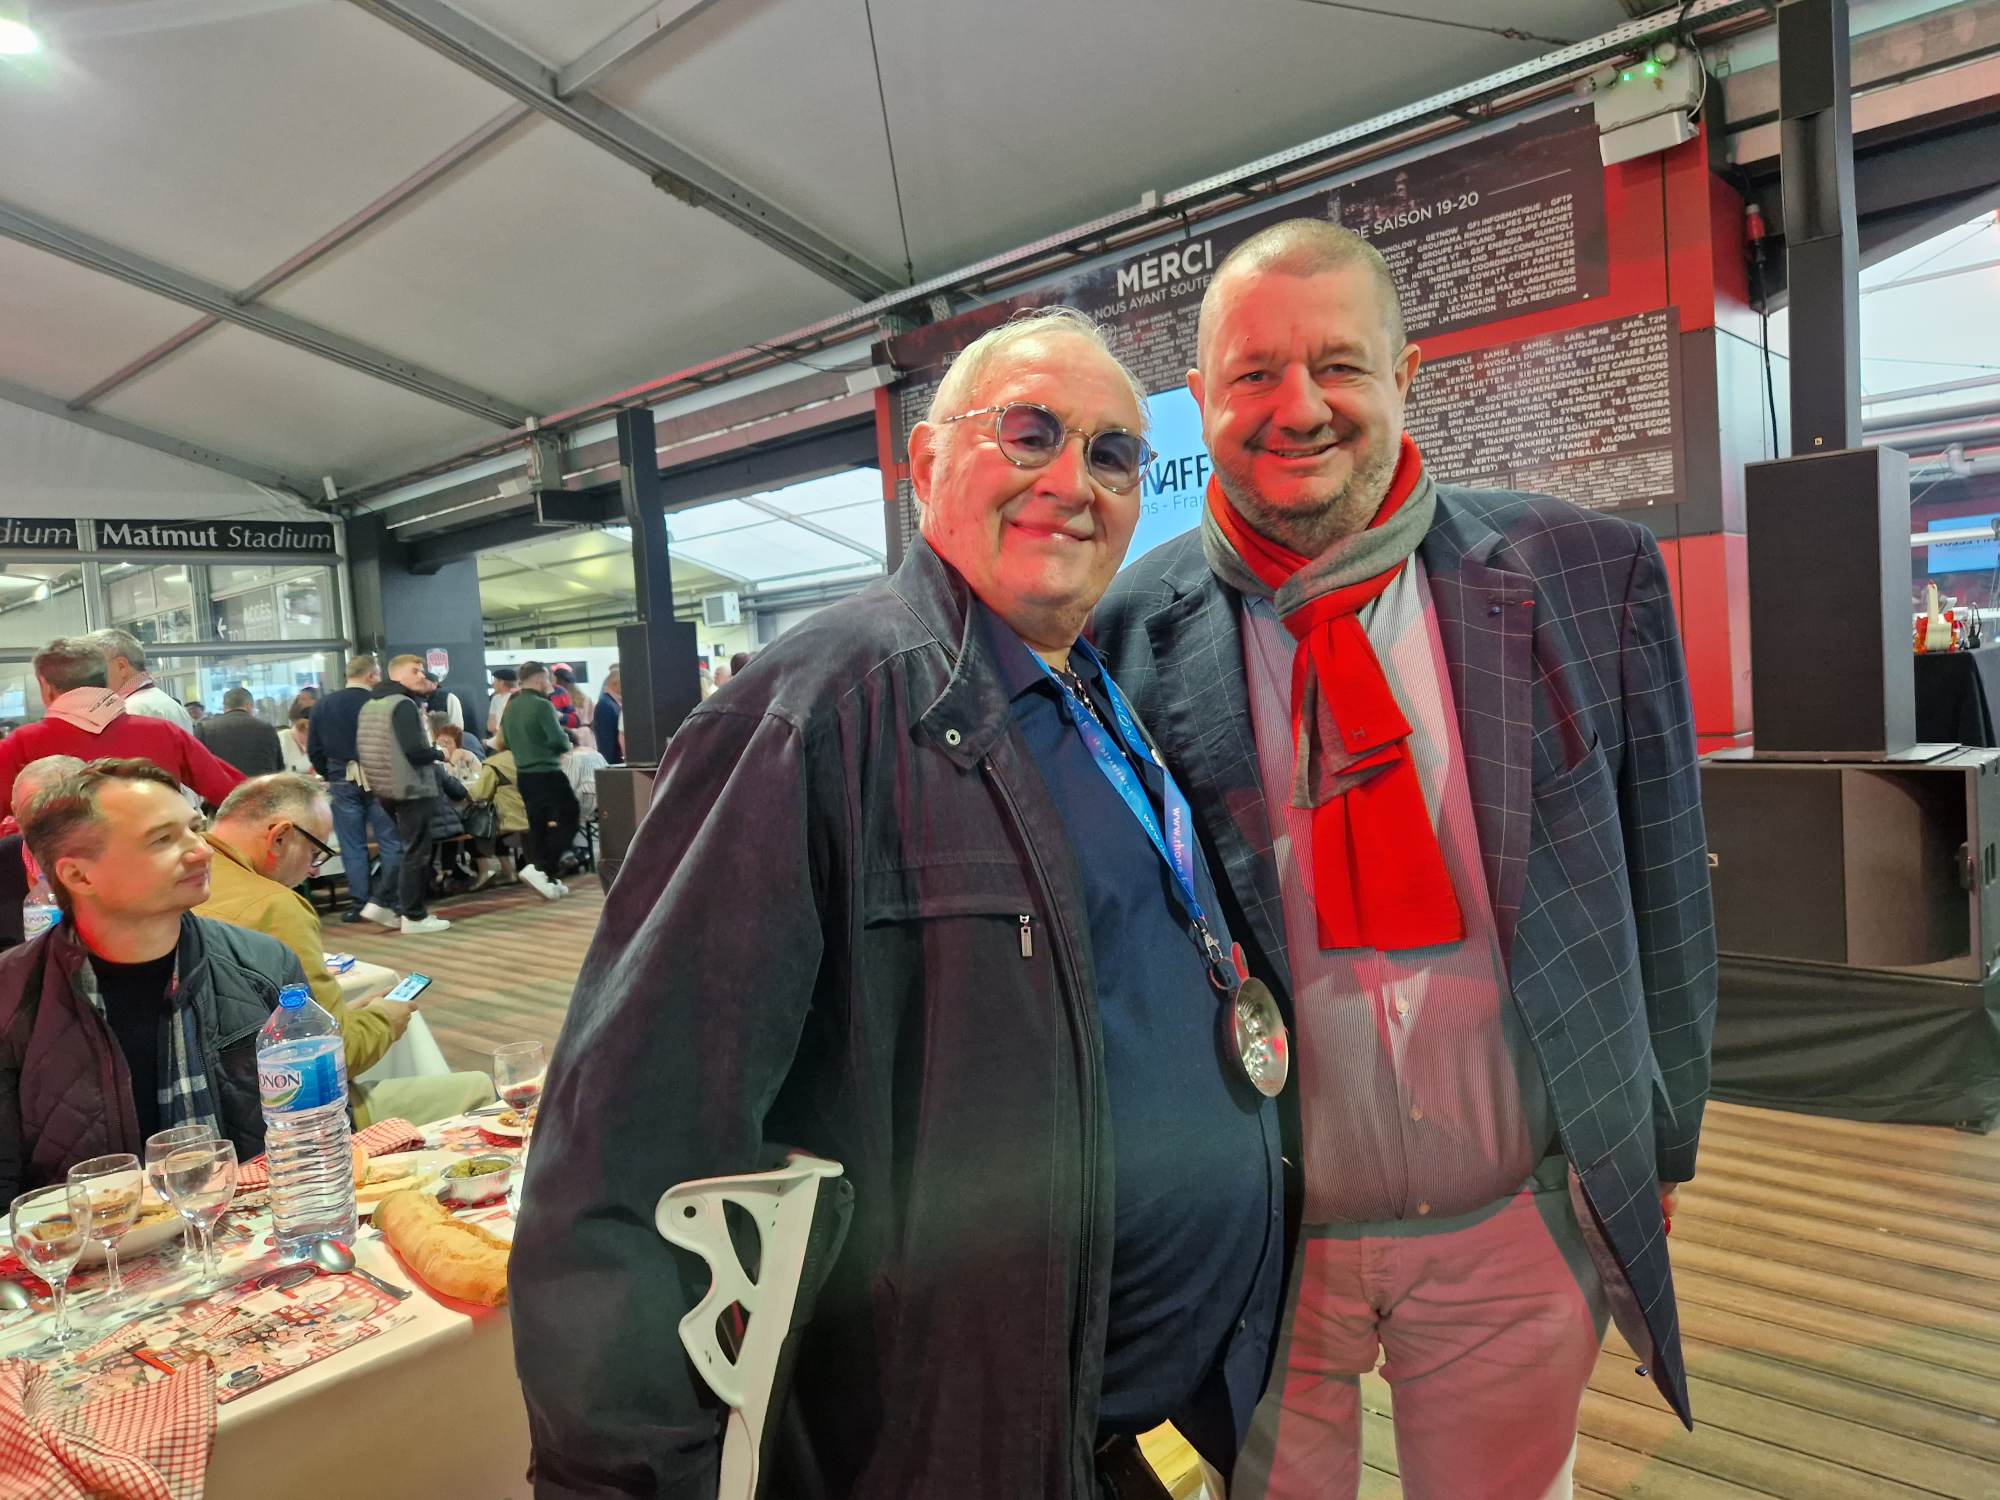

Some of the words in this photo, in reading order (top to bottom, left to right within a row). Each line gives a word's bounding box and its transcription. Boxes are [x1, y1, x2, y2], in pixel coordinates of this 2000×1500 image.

[1382, 238, 1416, 255] HNOLOGY
[1425, 226, 1458, 242] GETNOW
[1467, 220, 1480, 230] GFI
[1481, 202, 1540, 226] INFORMATIQUE
[1416, 234, 1461, 253] GROUPAMA
[1524, 202, 1572, 223] AUVERGNE
[1417, 255, 1447, 270] GROUPE
[1449, 251, 1459, 261] VT
[1487, 234, 1523, 251] ENERGIA
[1534, 220, 1573, 238] GUINTOLI
[1421, 245, 1451, 260] GROUPE
[1504, 221, 1538, 237] GROUPE
[1539, 211, 1573, 228] GACHET
[1094, 301, 1127, 319] NOUS
[1129, 288, 1167, 310] AYANT
[1170, 274, 1212, 297] SOUTE
[1374, 205, 1432, 235] SAISON
[1435, 190, 1479, 217] 19-20
[1117, 240, 1213, 297] MERCI
[1411, 267, 1434, 280] HOTEL
[1436, 262, 1450, 273] IBIS
[1451, 252, 1487, 269] GERLAND
[1513, 231, 1565, 252] CONSULTING
[1566, 229, 1574, 238] IT
[1428, 266, 1470, 284] INGENIERIE
[1472, 249, 1532, 272] COORDINATION
[1534, 238, 1574, 256] SERVICES
[1428, 286, 1457, 301] KEOLIS
[1460, 280, 1481, 293] LYON
[1494, 274, 1506, 284] LA
[1508, 260, 1560, 280] COMPAGNIE
[1562, 256, 1575, 266] DE
[1434, 279, 1453, 291] IPEM
[1467, 265, 1505, 282] ISOWATT
[1520, 259, 1529, 268] IT
[1532, 247, 1575, 265] PARTNER
[1404, 319, 1429, 332] ATION
[1438, 314, 1449, 324] LM
[1450, 303, 1496, 321] PROMOTION
[1506, 295, 1528, 307] LOCA
[1530, 283, 1576, 302] RECEPTION
[1446, 294, 1496, 313] LECAPITAINE
[1447, 295, 1458, 304] LA
[1459, 289, 1483, 301] TABLE
[1484, 286, 1495, 295] DE
[1496, 281, 1514, 292] MAX
[1522, 265, 1575, 286] LAGARRIGUE
[1412, 369, 1448, 384] ELECTRIC
[1459, 364, 1474, 374] SCP
[1476, 354, 1520, 370] D'AVOCATS
[1610, 331, 1628, 342] SCP
[1630, 323, 1666, 338] GAUVIN
[1426, 356, 1471, 372] METROPOLE
[1483, 347, 1509, 360] SAMSE
[1521, 338, 1551, 352] SAMSIC
[1563, 331, 1586, 343] SARL
[1621, 318, 1645, 330] SARL
[1648, 313, 1666, 325] T2M
[1445, 373, 1474, 385] SERFIM
[1486, 364, 1515, 377] SERFIM
[1518, 360, 1531, 370] TIC
[1544, 352, 1573, 365] SERGE
[1575, 343, 1614, 358] FERRARI
[1628, 332, 1667, 347] SEROBA
[1415, 386, 1451, 400] SEXTANT
[1454, 375, 1504, 392] ETIQUETTES
[1518, 364, 1556, 379] SIEMENS
[1559, 360, 1576, 371] SAS
[1591, 346, 1645, 364] SIGNATURE
[1648, 341, 1667, 353] SAS
[1418, 393, 1459, 408] IMMOBILIER
[1496, 382, 1512, 392] SNC
[1514, 374, 1550, 389] (SOCIETE
[1552, 365, 1595, 381] NOUVELLE
[1598, 362, 1610, 372] DE
[1611, 351, 1668, 369] CARRELAGE)
[1426, 398, 1474, 414] CONNEXIONS
[1485, 390, 1517, 403] SOCIETE
[1596, 372, 1606, 381] ET
[1609, 360, 1668, 379] PRESTATIONS
[1448, 409, 1464, 419] SOFI
[1474, 402, 1500, 414] SOGEA
[1502, 396, 1529, 408] RHONE
[1532, 391, 1557, 403] ALPES
[1568, 386, 1584, 396] SOL
[1586, 377, 1627, 392] NUANCES
[1638, 369, 1668, 383] SOLOC
[1408, 422, 1438, 435] OVITRAT
[1517, 401, 1549, 414] SYMBOL
[1551, 397, 1573, 408] CARS
[1575, 389, 1615, 404] MOBILITY
[1625, 379, 1669, 394] SYNDICAT
[1441, 442, 1472, 454] GROUPE
[1483, 426, 1563, 446] TRANSFORMATEURS
[1566, 417, 1614, 432] SOLUTIONS
[1617, 407, 1669, 423] VENISSIEUX
[1450, 426, 1461, 435] DU
[1462, 419, 1499, 433] FROMAGE
[1500, 410, 1550, 426] ABONDANCE
[1559, 401, 1600, 415] SYNERGIE
[1627, 388, 1669, 403] SERVICES
[1453, 433, 1473, 443] TECH
[1475, 424, 1522, 439] MENUISERIE
[1534, 414, 1575, 429] TERIDEAL
[1583, 407, 1616, 420] TARVEL
[1629, 397, 1669, 412] TOSHIBA
[1431, 451, 1465, 464] VIVARAIS
[1559, 428, 1600, 442] POMMERY
[1611, 424, 1627, 433] VDI
[1630, 416, 1670, 430] TELECOM
[1447, 460, 1462, 469] EAU
[1471, 452, 1510, 465] VERTILINK
[1512, 450, 1522, 459] SA
[1532, 445, 1554, 455] VICAT
[1557, 439, 1591, 451] FRANCE
[1601, 431, 1636, 444] VILOGIA
[1647, 425, 1670, 436] VINCI
[1450, 466, 1479, 477] CENTRE
[1507, 456, 1539, 468] VISIATIV
[1567, 443, 1617, 458] EMBALLAGE
[1142, 501, 1159, 515] ns
[103, 523, 218, 547] Matmut
[227, 526, 331, 549] Stadium
